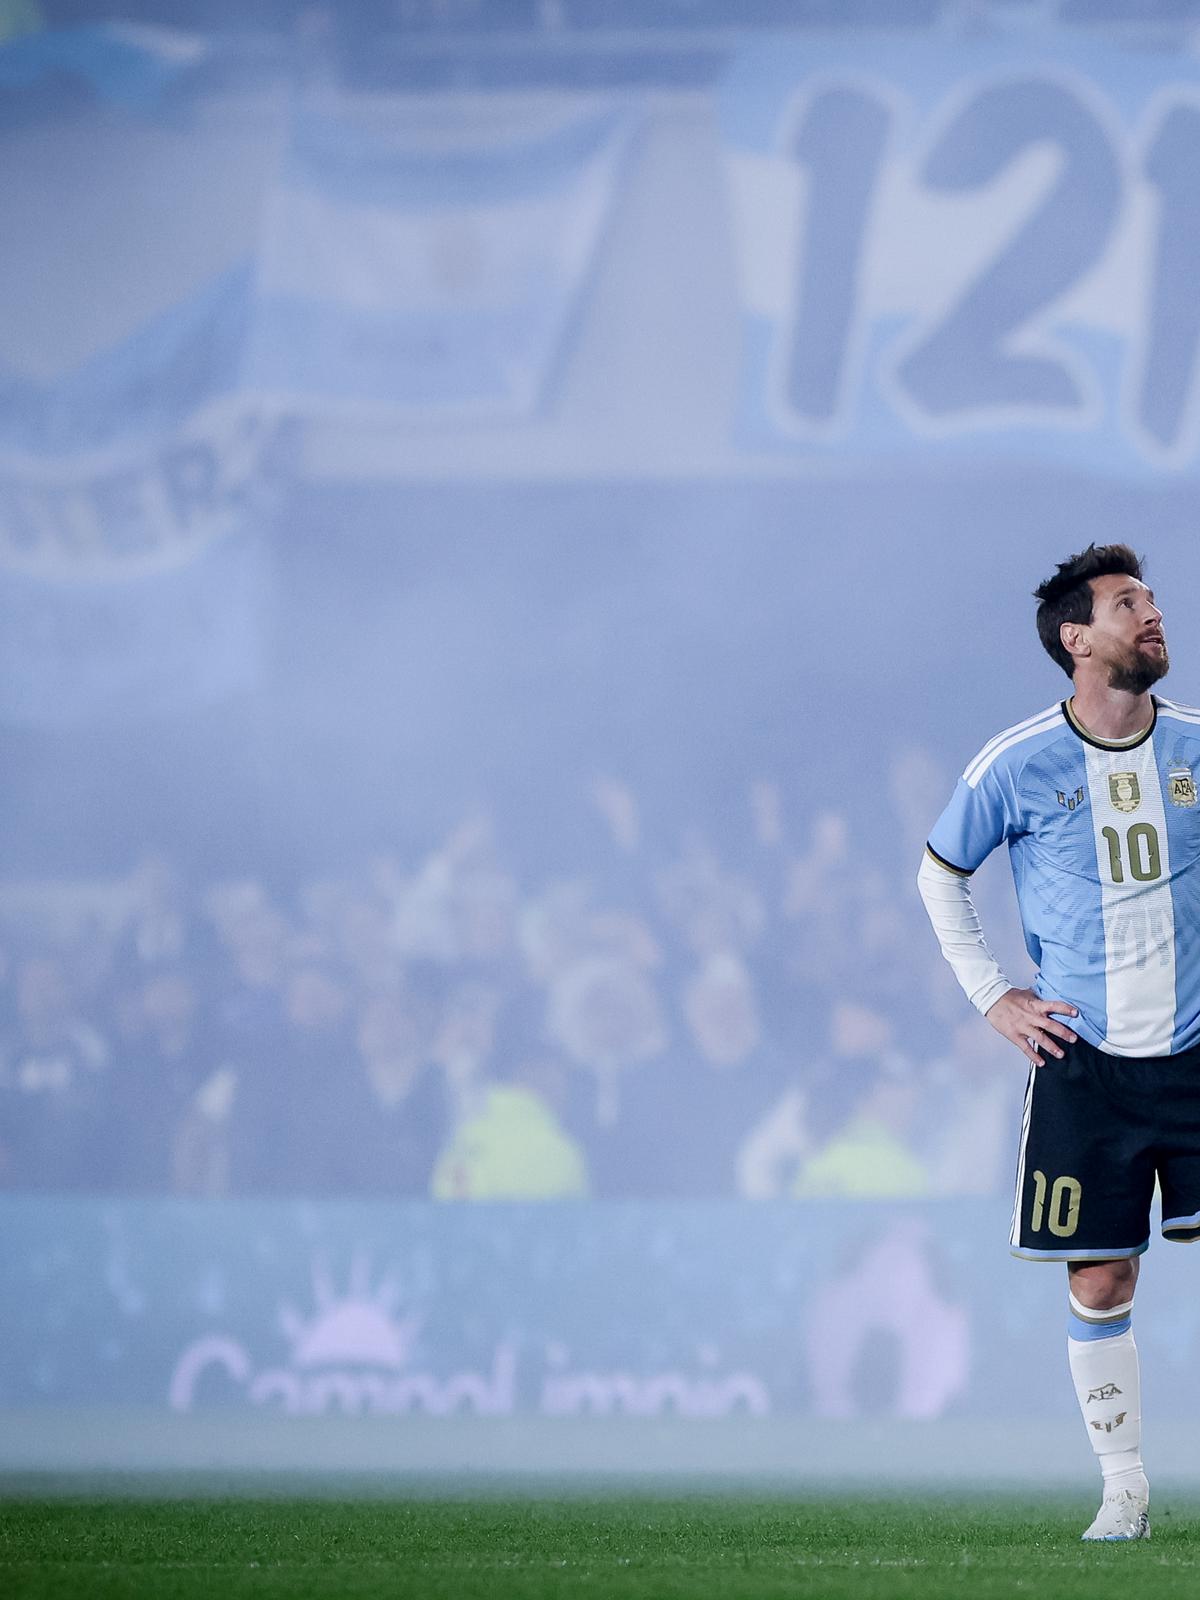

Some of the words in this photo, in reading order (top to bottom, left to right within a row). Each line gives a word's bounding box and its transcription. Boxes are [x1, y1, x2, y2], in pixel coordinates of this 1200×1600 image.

[1174, 778, 1192, 796] AFA
[1101, 822, 1162, 883] 10
[1031, 1169, 1082, 1238] 10
[1086, 1382, 1123, 1404] AFA
